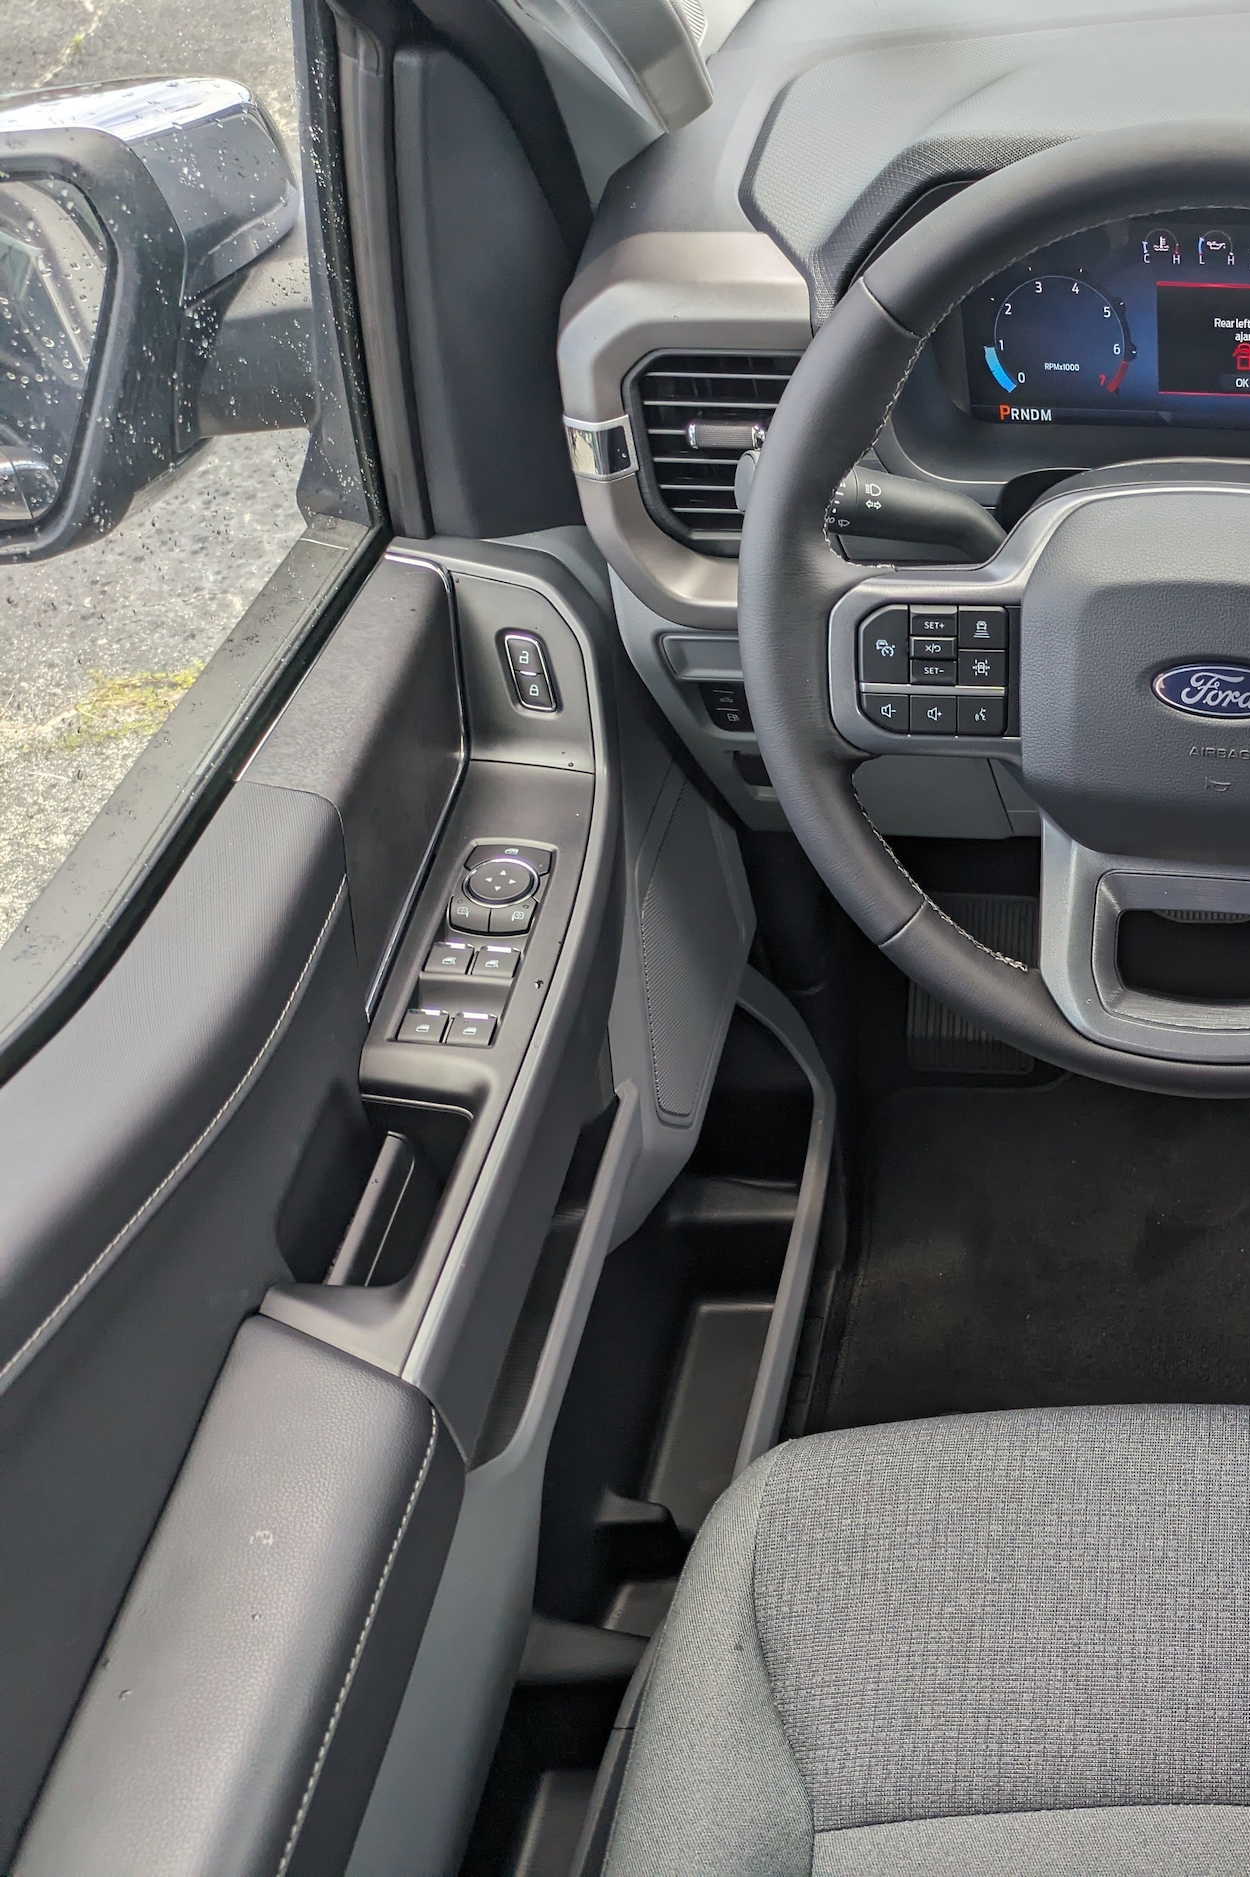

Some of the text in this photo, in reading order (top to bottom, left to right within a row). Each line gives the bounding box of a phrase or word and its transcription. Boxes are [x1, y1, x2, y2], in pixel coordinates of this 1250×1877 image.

[1143, 254, 1150, 263] C
[1173, 255, 1180, 264] H
[1228, 256, 1234, 265] H
[1035, 281, 1043, 293] 3
[1072, 282, 1080, 294] 4
[1004, 303, 1012, 315] 2
[1103, 306, 1111, 318] 5
[1214, 317, 1235, 328] Rear
[1236, 318, 1250, 329] left
[999, 339, 1004, 350] 1
[1113, 344, 1121, 354] 6
[1044, 363, 1080, 371] RPMx1000
[1018, 372, 1026, 383] 0
[1100, 374, 1106, 385] 7
[1235, 378, 1249, 388] OK
[1189, 746, 1250, 760] AIRBAG
